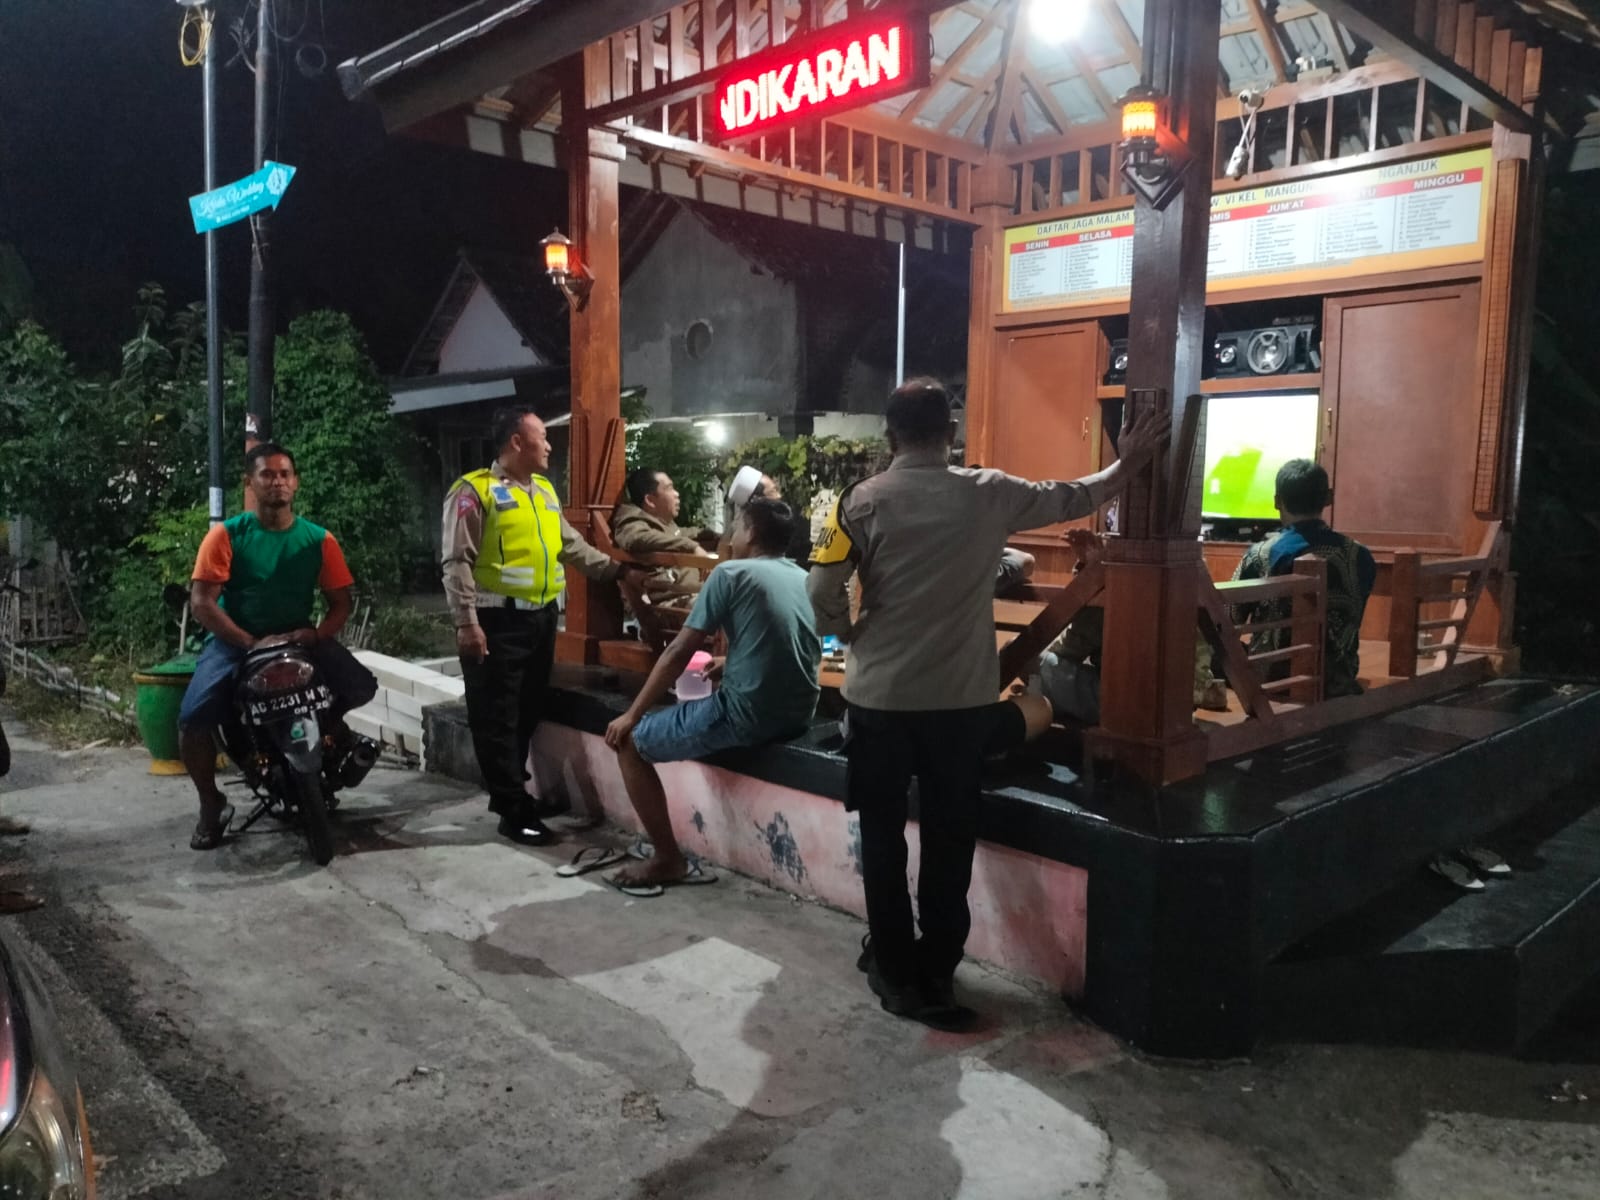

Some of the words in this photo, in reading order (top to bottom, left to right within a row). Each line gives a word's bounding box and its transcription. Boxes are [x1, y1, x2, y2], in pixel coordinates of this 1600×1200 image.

[1025, 240, 1050, 251] SENIN
[1078, 229, 1112, 242] SELASA
[1413, 173, 1465, 190] MINGGU
[1036, 222, 1069, 236] DAFTAR
[1071, 217, 1094, 230] JAGA
[1095, 211, 1130, 225] MALAM
[1238, 190, 1257, 203] KEL
[1378, 160, 1439, 179] NGANJUK
